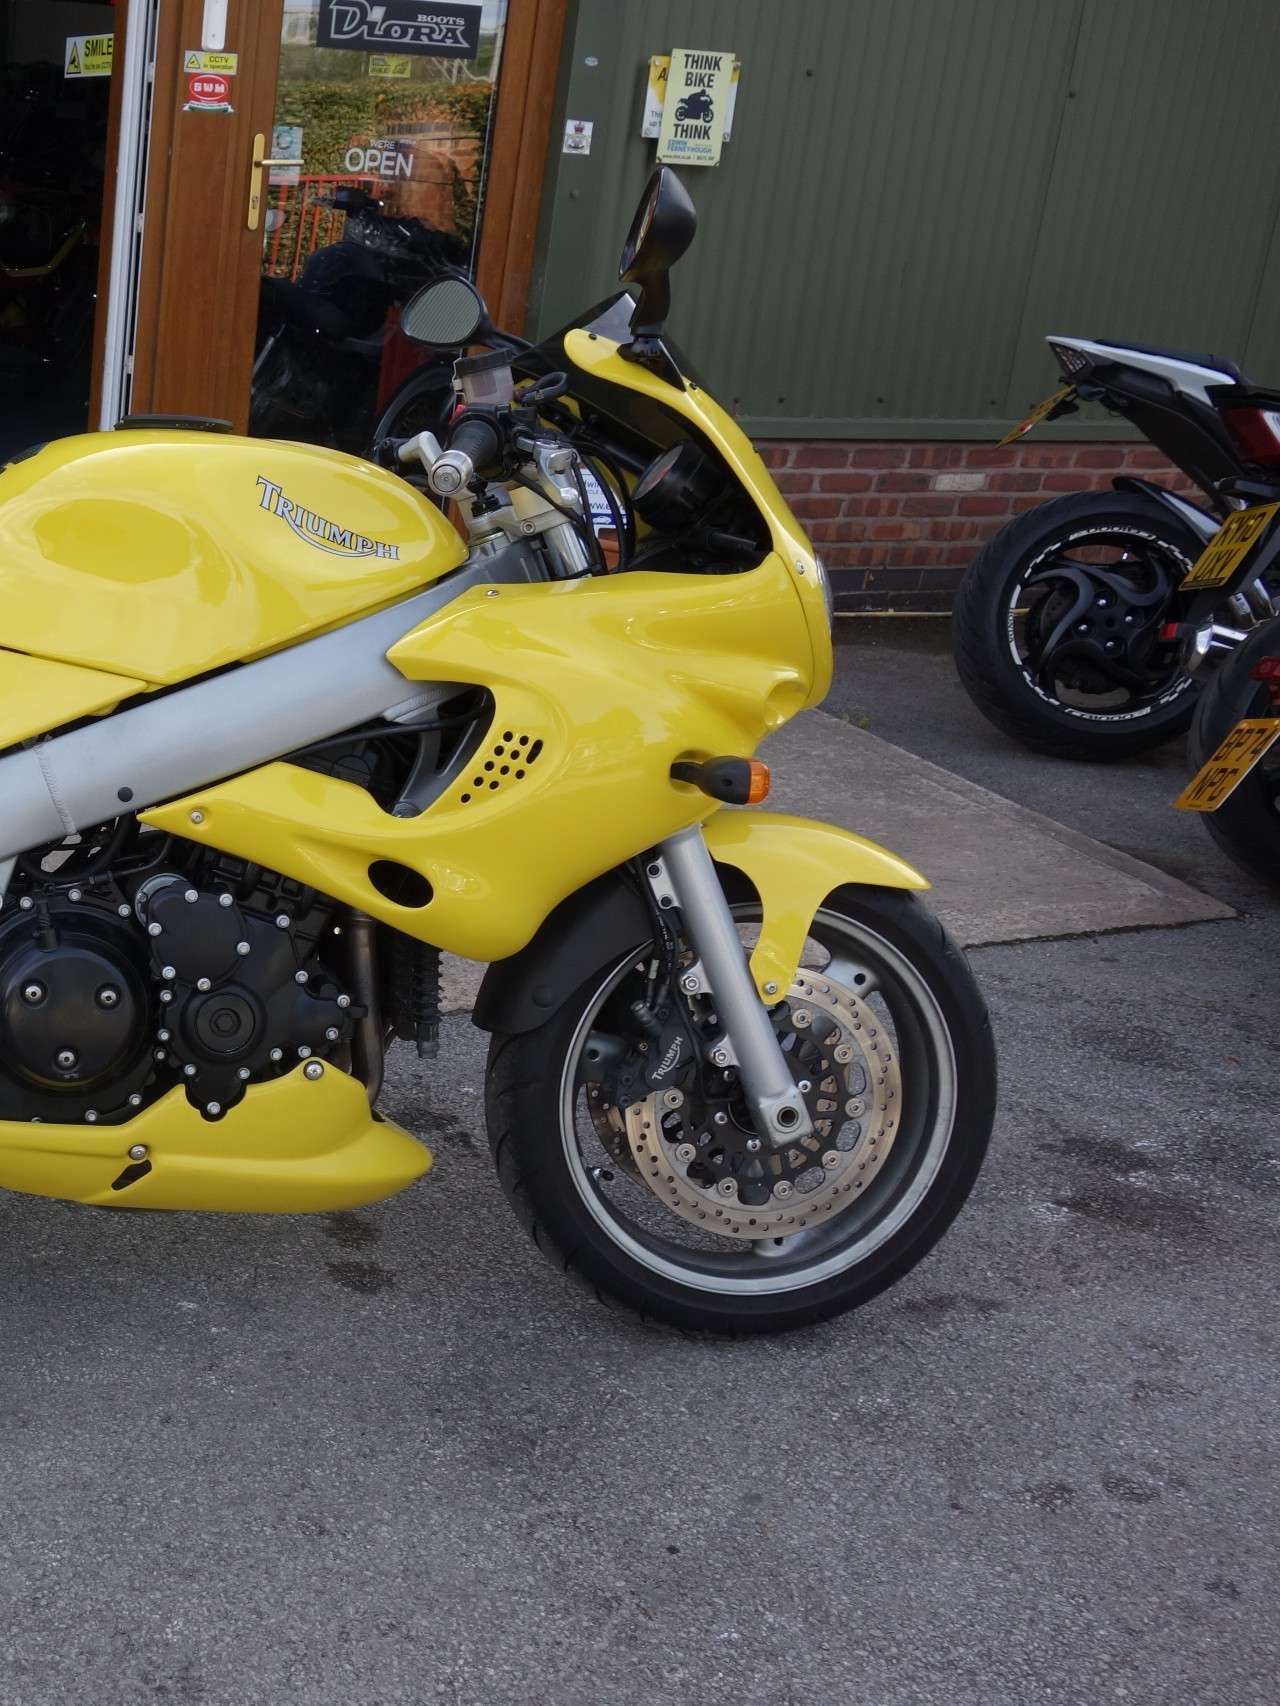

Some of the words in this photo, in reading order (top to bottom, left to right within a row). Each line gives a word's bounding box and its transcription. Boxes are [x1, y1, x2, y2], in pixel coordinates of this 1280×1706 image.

[417, 14, 465, 25] BOOTS
[84, 38, 113, 56] SMILE
[209, 56, 229, 64] CCTV
[684, 53, 723, 72] THINK
[684, 72, 715, 88] BIKE
[673, 123, 713, 140] THINK
[344, 147, 414, 177] OPEN
[255, 475, 400, 560] TRIUMPH
[1211, 727, 1280, 763] BP74
[651, 1036, 684, 1081] TRIUMPH
